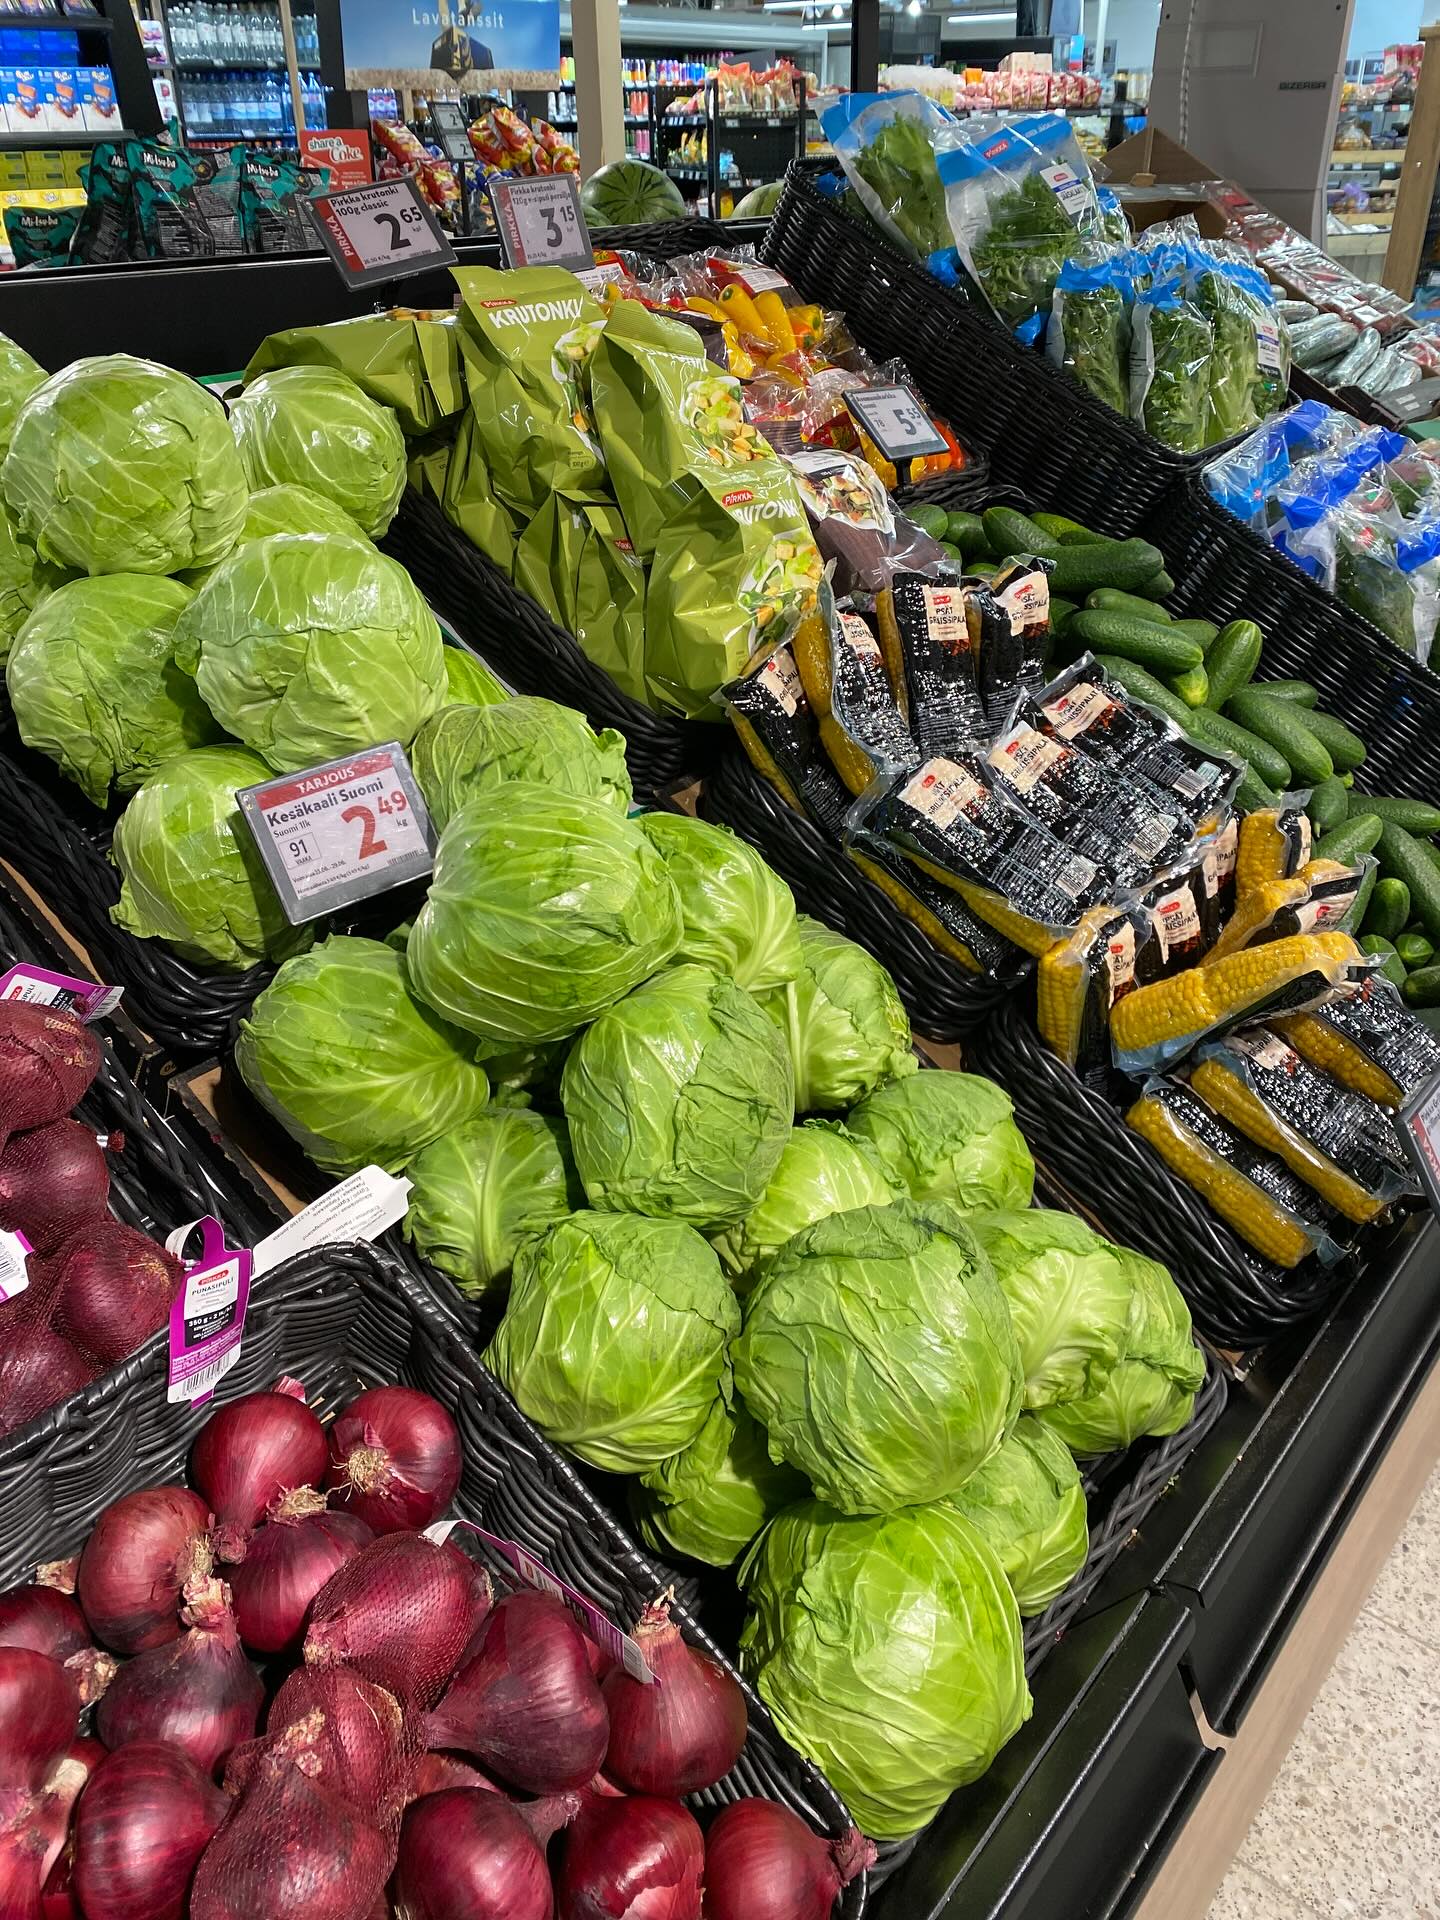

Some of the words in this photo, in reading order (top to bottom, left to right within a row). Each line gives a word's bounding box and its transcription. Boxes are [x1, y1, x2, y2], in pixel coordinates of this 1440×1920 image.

[412, 8, 504, 29] Lavatanssit
[1279, 82, 1327, 90] BIZERBA
[309, 137, 333, 150] share
[334, 140, 342, 148] a
[330, 145, 361, 162] Coke
[331, 193, 361, 208] Pirkka
[361, 185, 400, 202] krutonki
[336, 206, 361, 218] 100g
[361, 199, 389, 213] classic
[326, 215, 354, 257] PIRKKA
[373, 212, 412, 251] 2
[400, 206, 424, 224] 65
[504, 203, 521, 250] PIRKKA
[540, 208, 563, 248] 3
[560, 205, 575, 222] 15
[488, 298, 582, 329] KRUTONKI
[893, 409, 917, 436] 5
[905, 407, 921, 420] 55
[725, 492, 753, 505] PIRKKA
[296, 767, 355, 794] TARJOUS
[267, 792, 339, 828] Kesäkaali
[341, 778, 385, 802] Suomi
[273, 824, 299, 839] Suomi
[341, 805, 388, 861] 2
[378, 790, 408, 816] 49
[396, 817, 408, 828] kg
[289, 839, 309, 858] 91
[295, 855, 313, 866] VAAKA
[191, 1276, 234, 1296] PUNASIPULI
